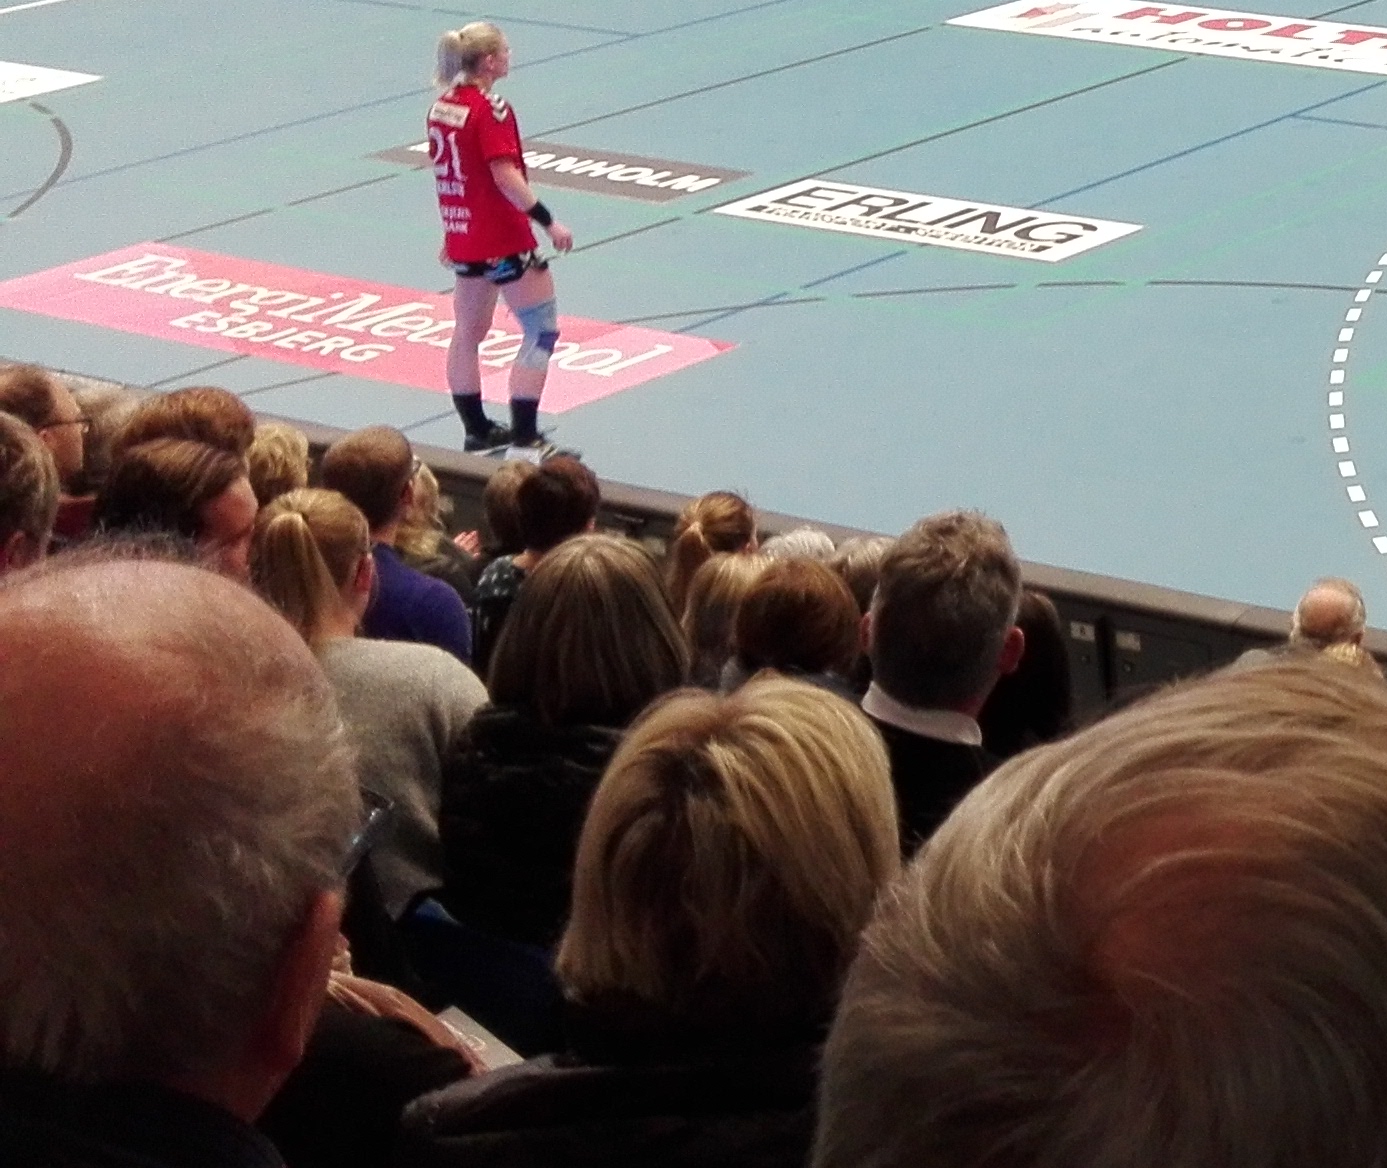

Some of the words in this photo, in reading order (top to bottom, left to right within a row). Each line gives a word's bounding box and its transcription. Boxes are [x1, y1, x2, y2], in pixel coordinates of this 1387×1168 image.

[429, 126, 467, 182] 21
[771, 185, 1099, 245] ERLING
[170, 310, 396, 364] ESBJERG
